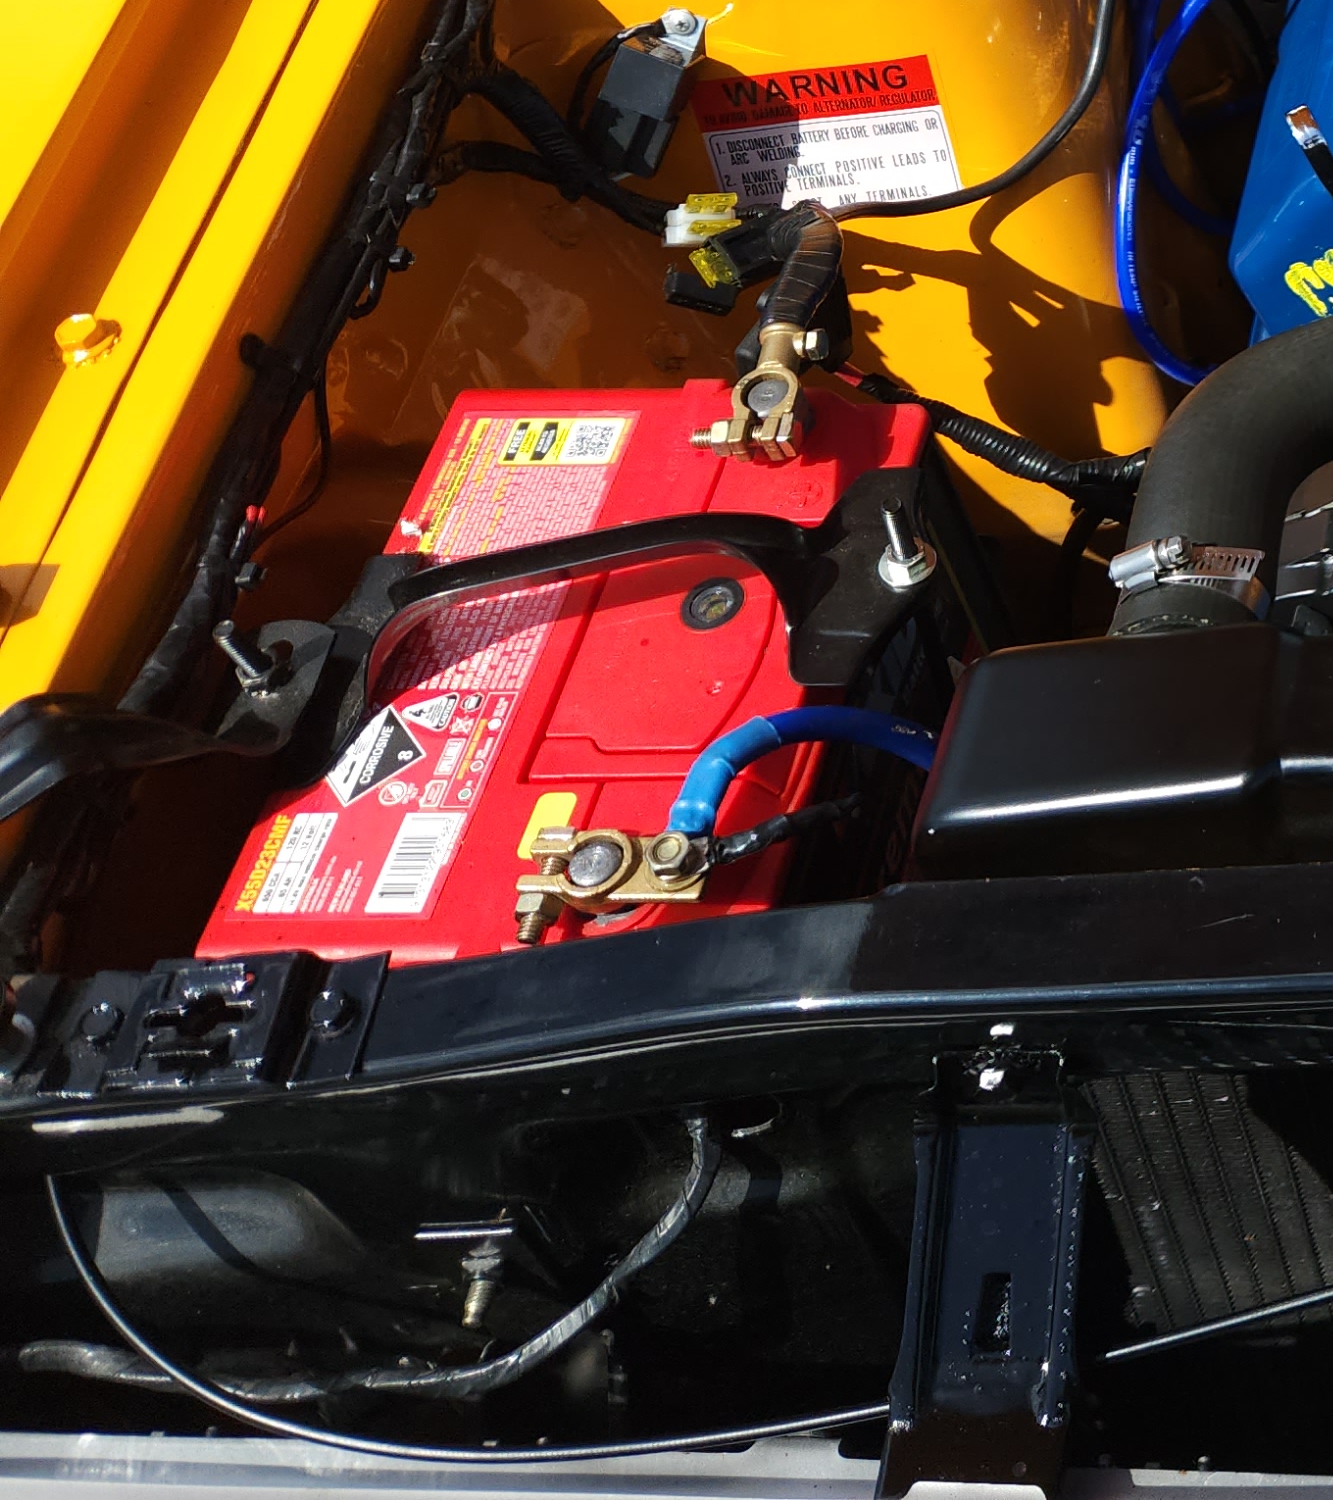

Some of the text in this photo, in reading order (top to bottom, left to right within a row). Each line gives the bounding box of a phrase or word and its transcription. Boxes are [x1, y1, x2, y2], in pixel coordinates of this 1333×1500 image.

[722, 65, 908, 107] WARNING
[879, 88, 937, 107] REGULATOR
[726, 133, 785, 153] DISCONNECT
[790, 129, 830, 145] BATTERY
[834, 124, 870, 141] BEFORE
[872, 120, 920, 137] CHARGING
[924, 117, 939, 131] OR
[724, 149, 948, 188] 2. ALWAYS CONNECT POSITIVE LEADS TO
[730, 145, 806, 166] ARC WELDING.
[744, 173, 861, 198] POSITIVE TERMINALS.
[838, 193, 857, 206] ANY
[866, 185, 933, 202] TERMINALS.
[359, 725, 395, 785] CORROSIVE
[397, 749, 414, 763] 8
[234, 814, 293, 913] X55D23CMF
